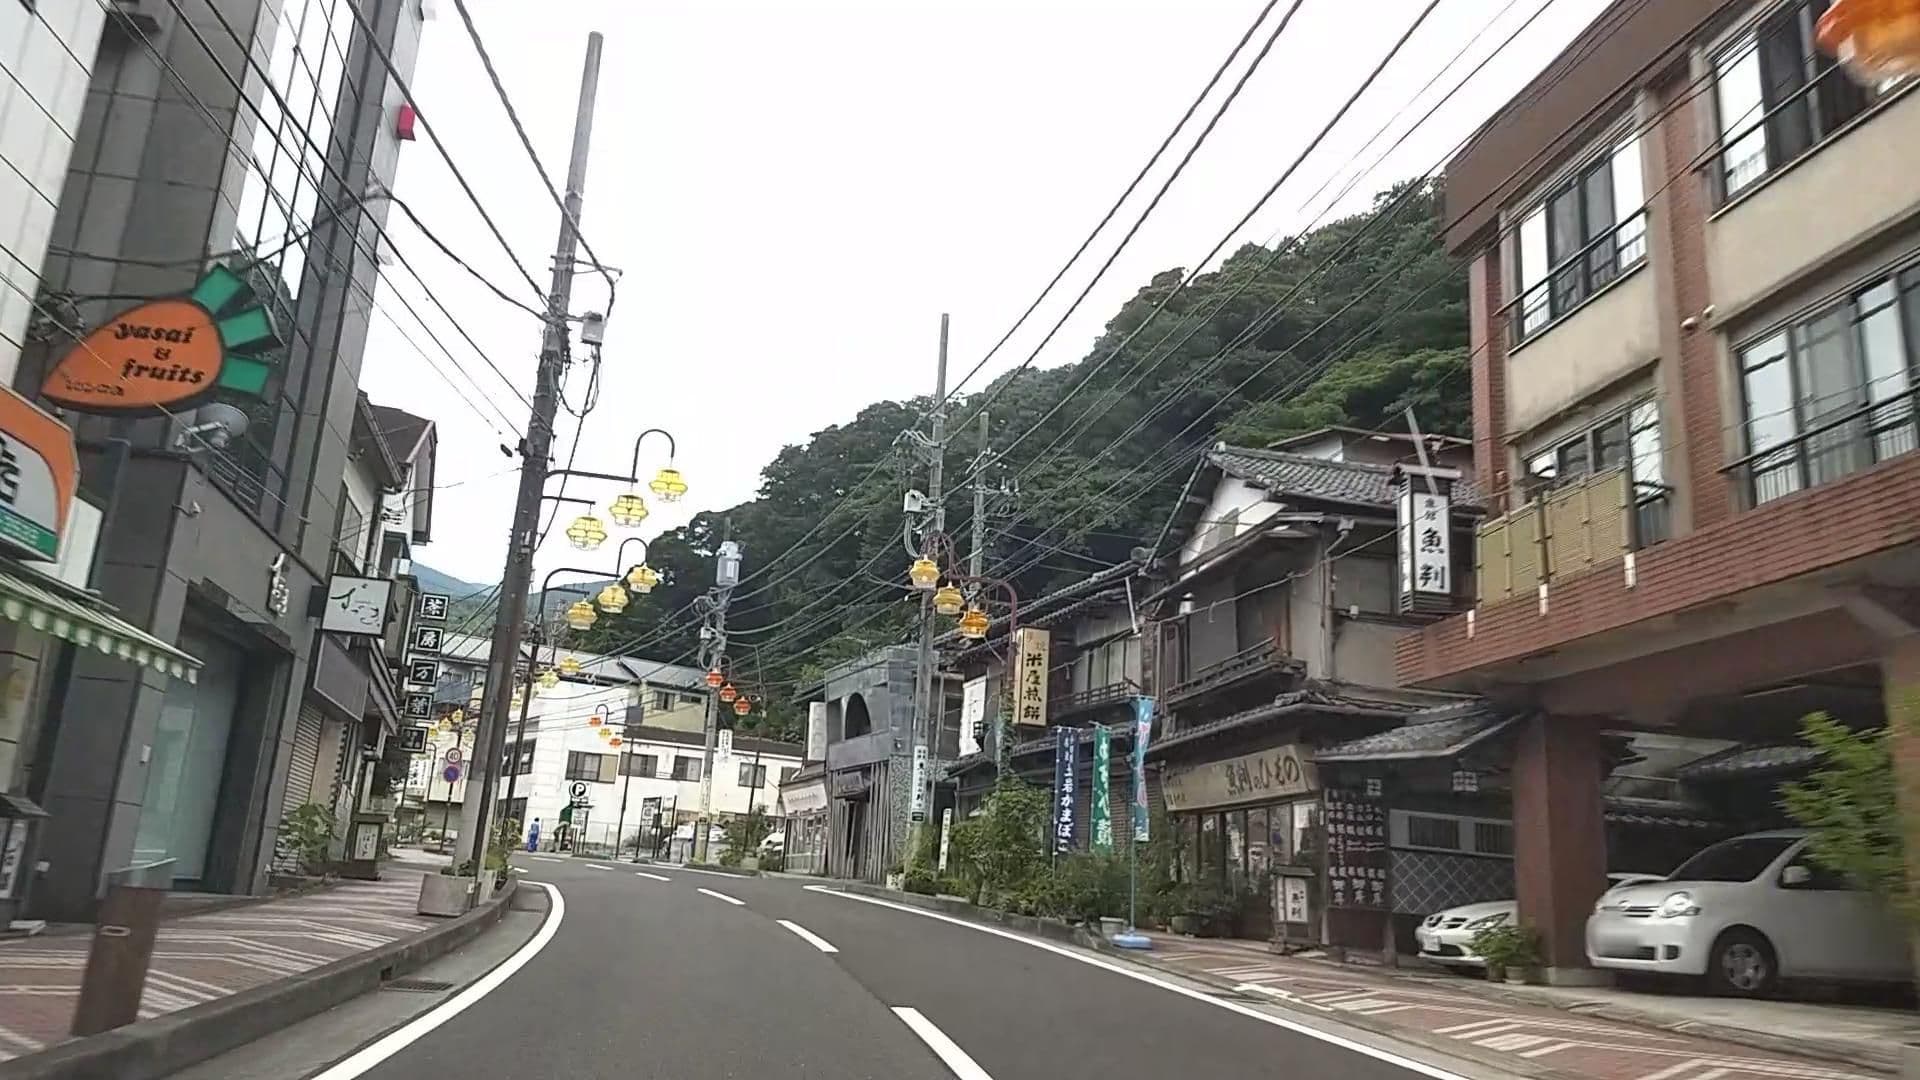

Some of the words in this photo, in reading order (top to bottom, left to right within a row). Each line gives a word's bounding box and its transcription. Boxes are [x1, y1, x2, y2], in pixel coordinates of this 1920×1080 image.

[114, 322, 197, 344] yasai
[120, 358, 205, 385] fruits
[1023, 652, 1043, 721] 米屋煎餅
